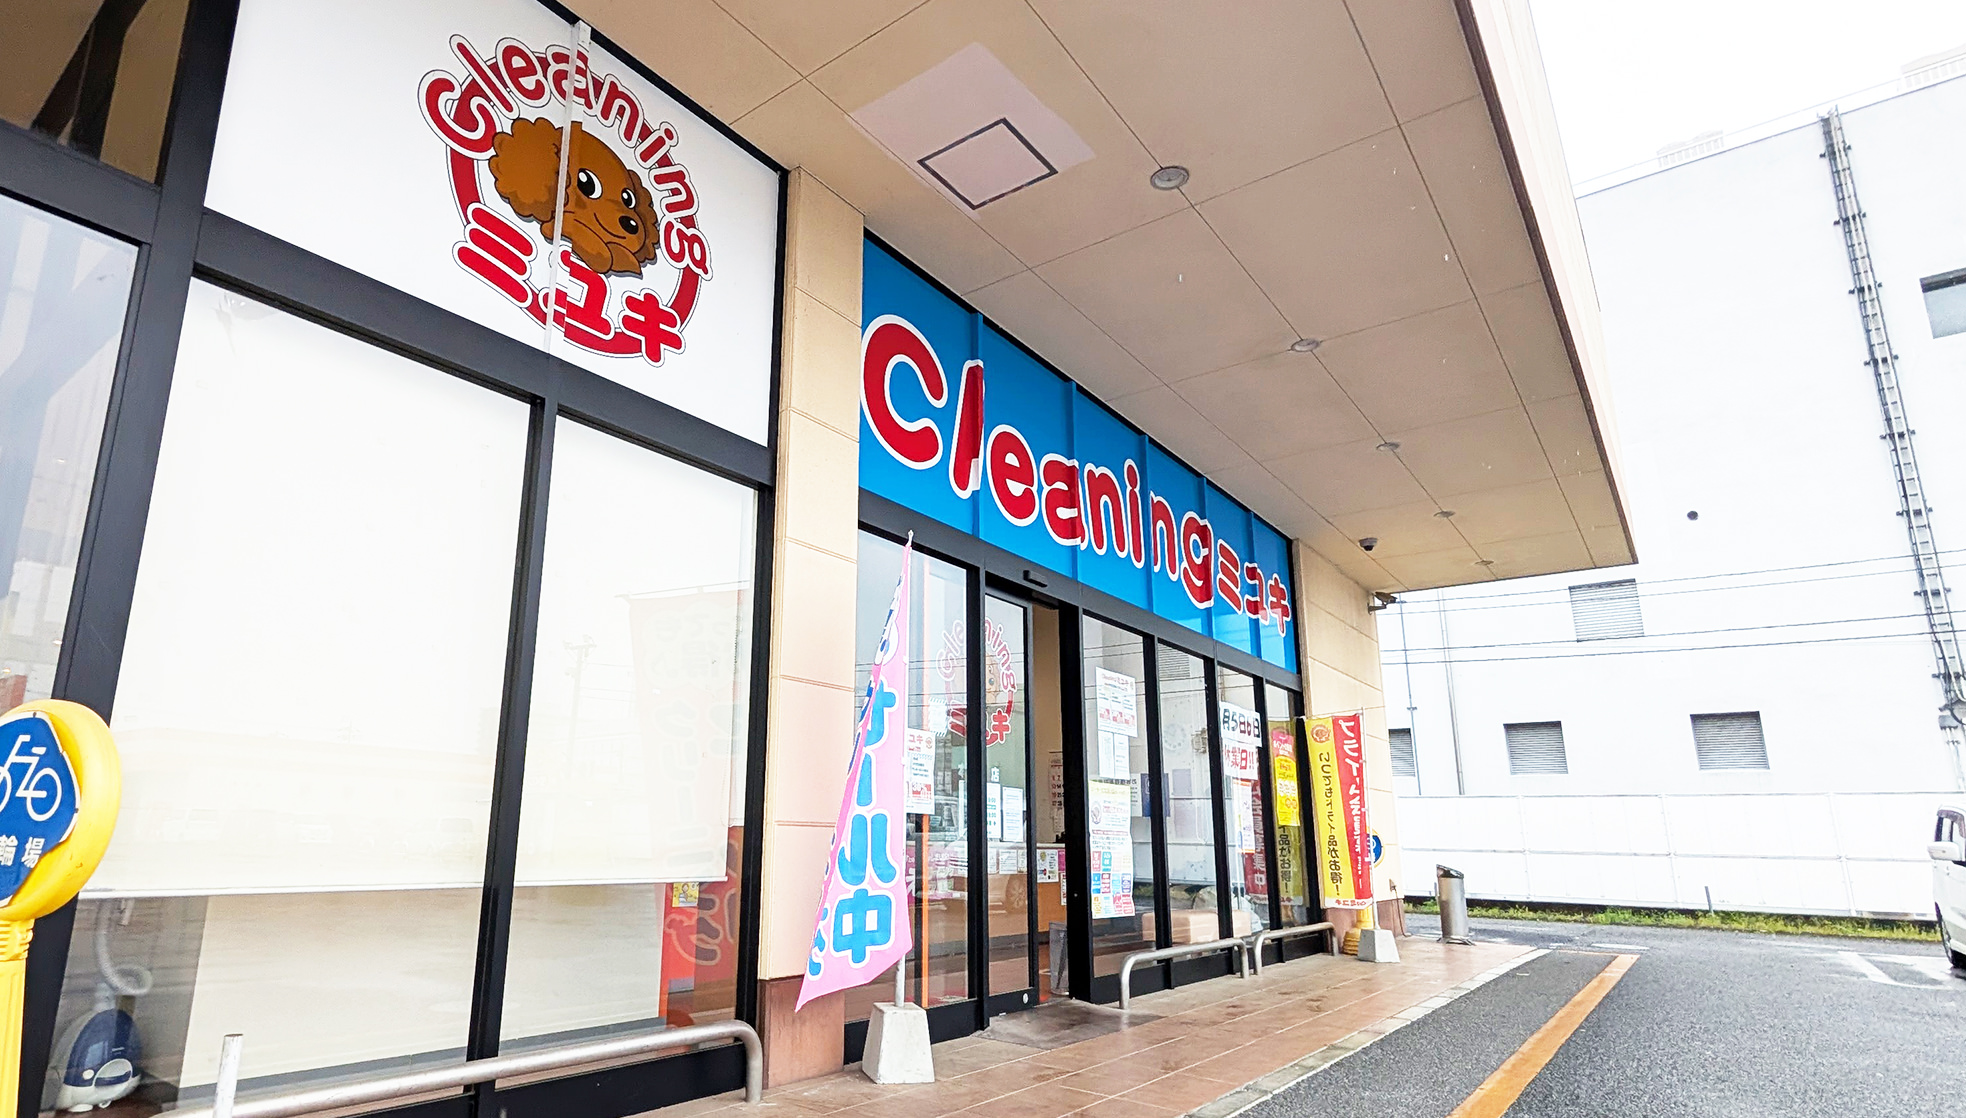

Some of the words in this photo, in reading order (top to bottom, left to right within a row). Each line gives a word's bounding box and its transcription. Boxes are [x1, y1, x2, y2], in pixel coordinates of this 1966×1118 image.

[417, 33, 713, 281] Cleaning
[452, 202, 686, 367] ミユキ
[935, 618, 1018, 692] Clening
[947, 700, 1012, 747] ミキ
